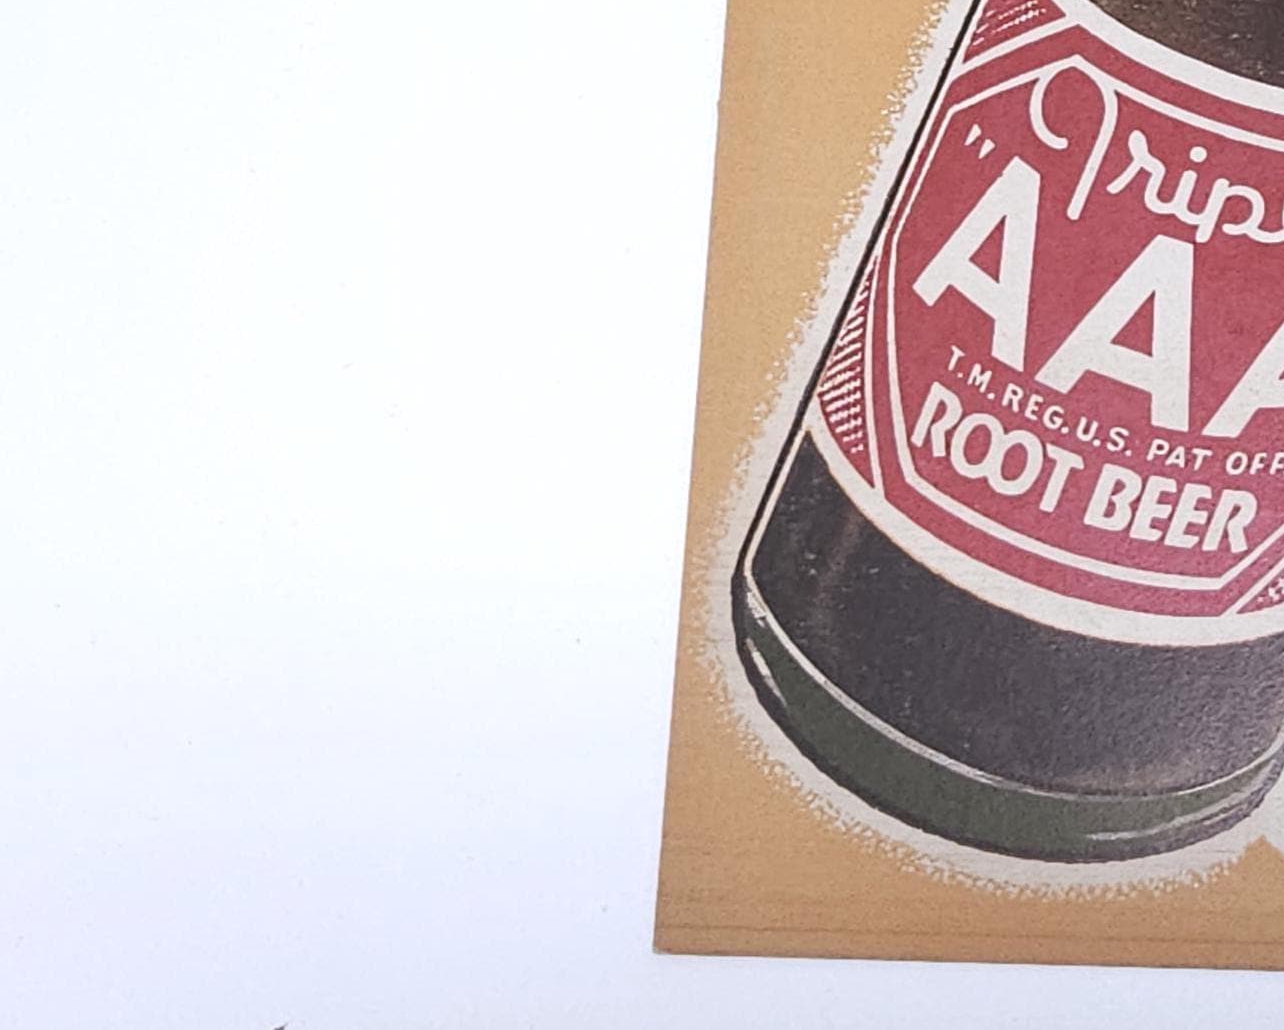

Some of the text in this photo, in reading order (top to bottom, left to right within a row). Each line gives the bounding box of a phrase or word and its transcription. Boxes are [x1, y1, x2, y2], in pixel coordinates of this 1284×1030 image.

[911, 381, 1258, 554] ROOT BEER
[1146, 438, 1213, 471] PAT
